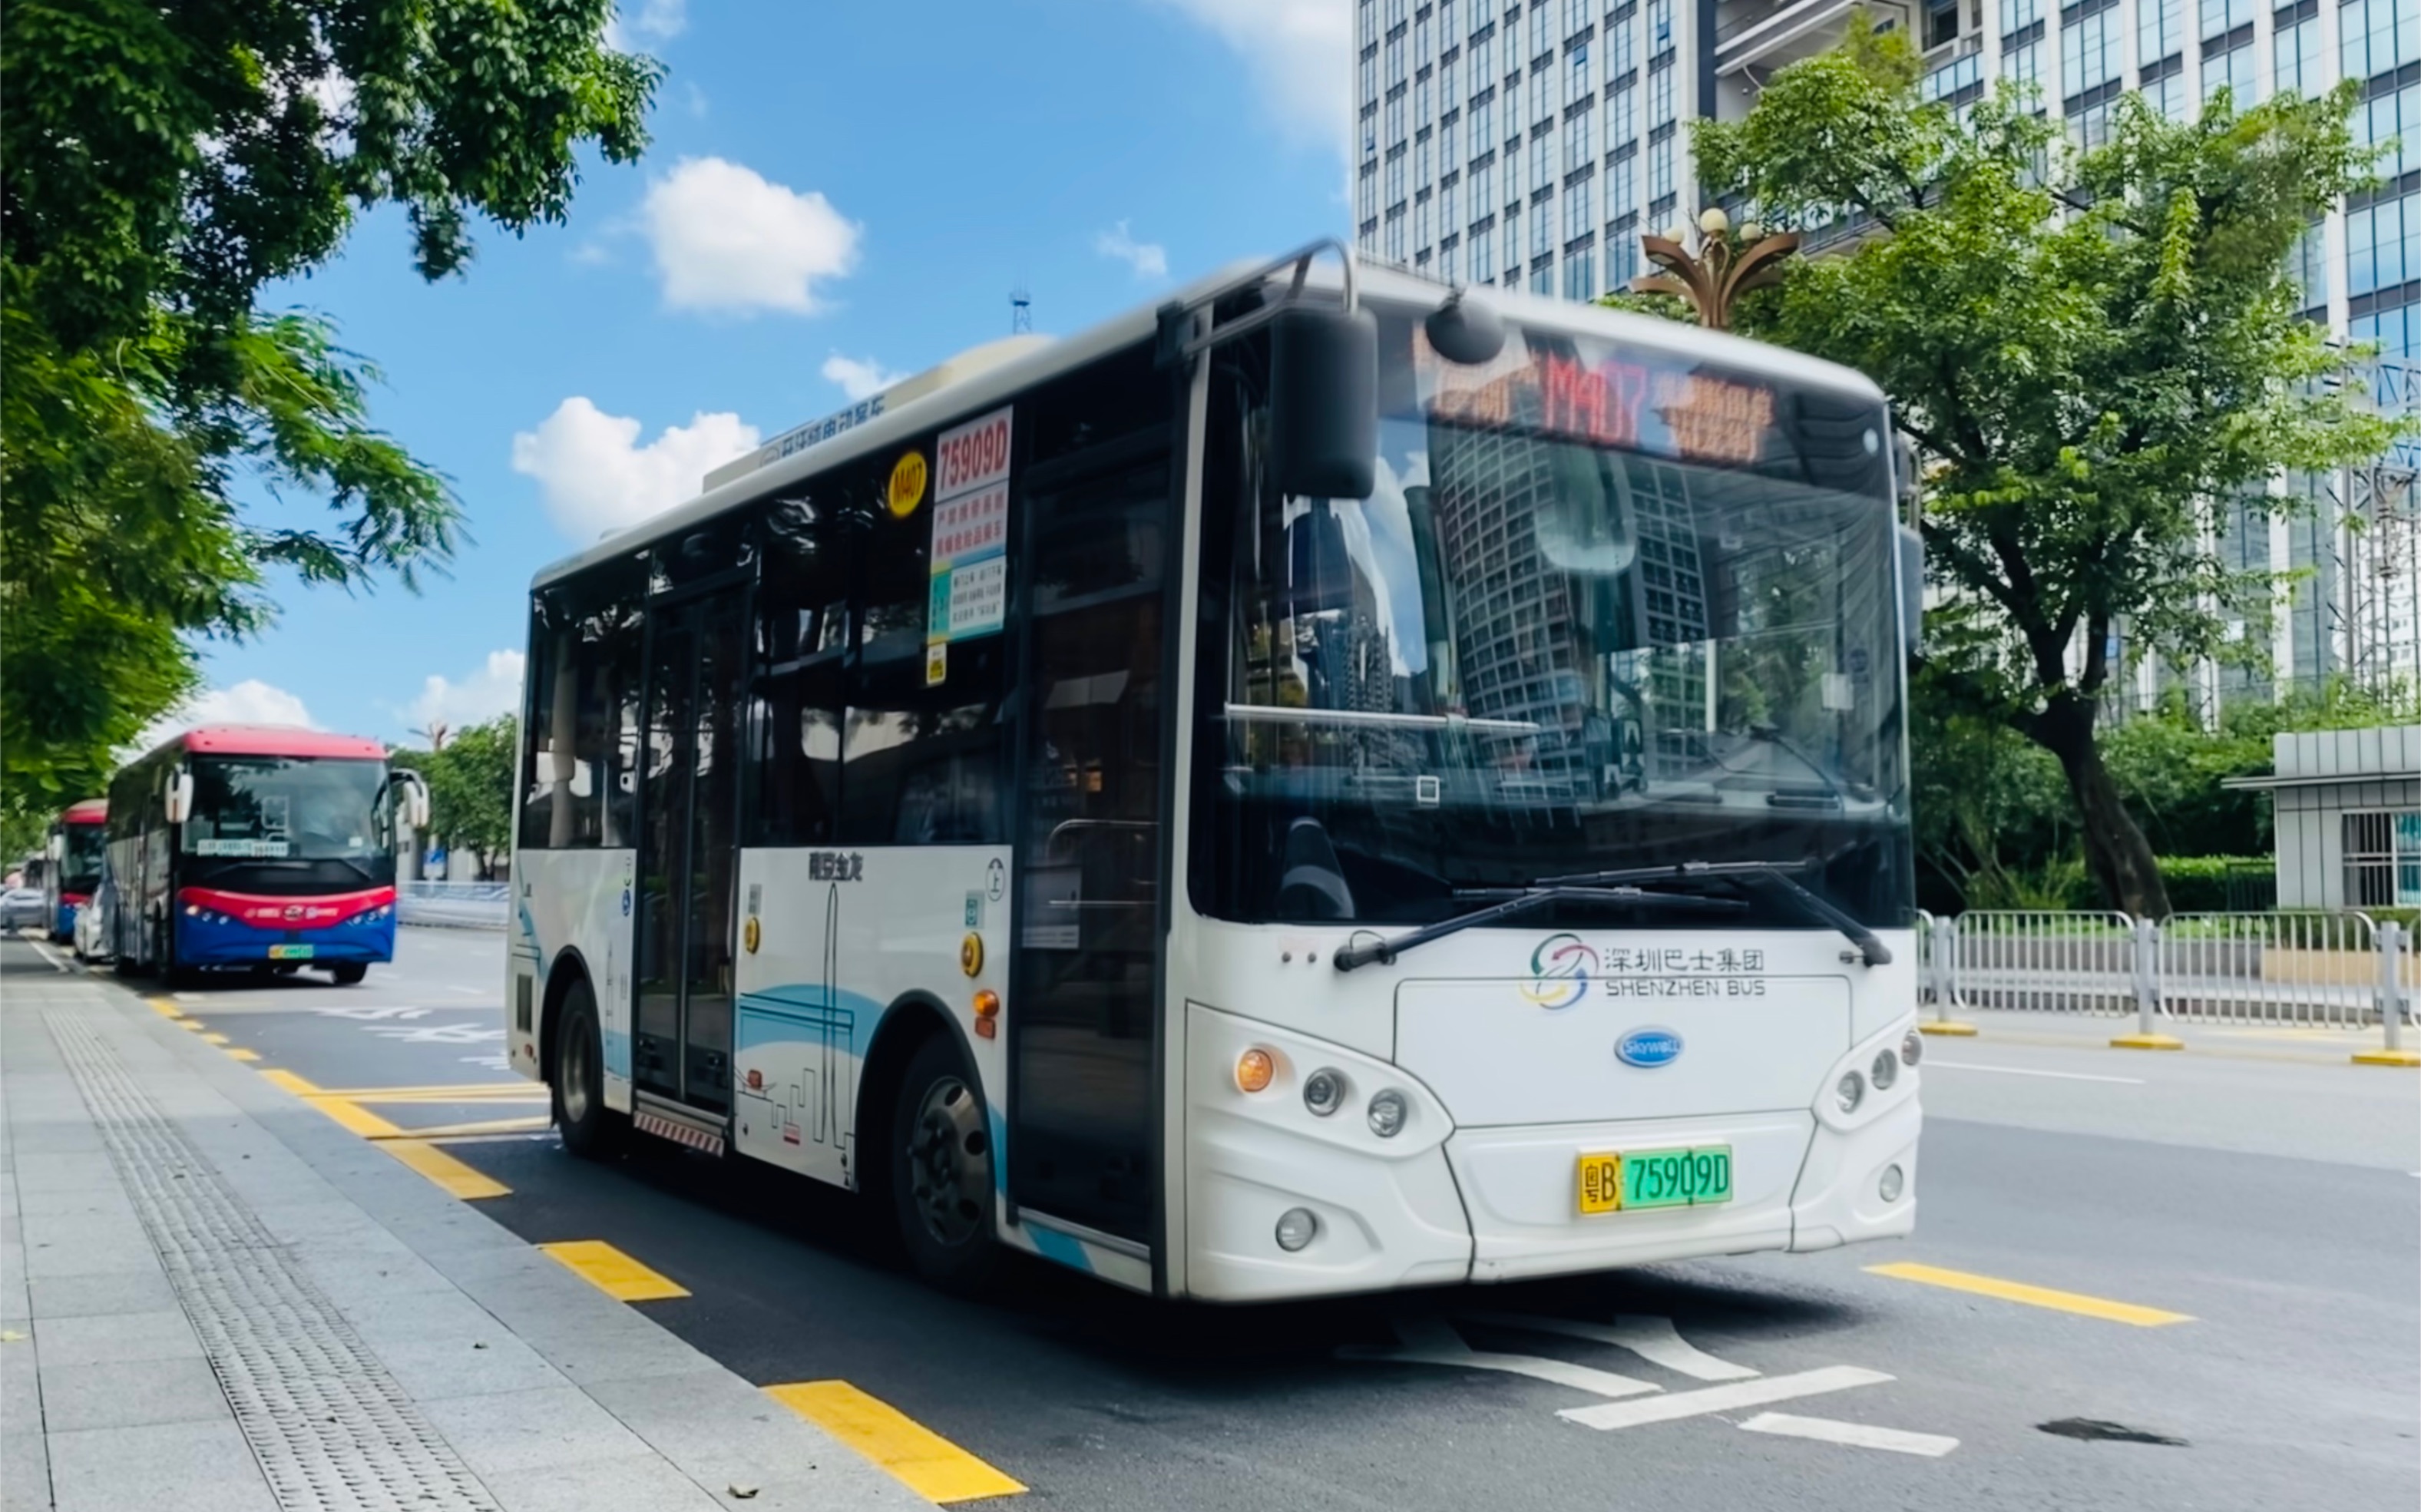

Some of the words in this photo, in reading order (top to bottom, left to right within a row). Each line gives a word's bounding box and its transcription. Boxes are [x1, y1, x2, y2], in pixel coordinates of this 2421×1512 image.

[1544, 351, 1648, 445] M407
[940, 419, 1008, 492] 75909D
[809, 851, 864, 882] 南京金龙
[1605, 948, 1764, 973] 深圳巴士集团
[1606, 979, 1719, 997] SHENZHEN
[1727, 979, 1766, 996] BUS
[1630, 1153, 1729, 1201] 75909D
